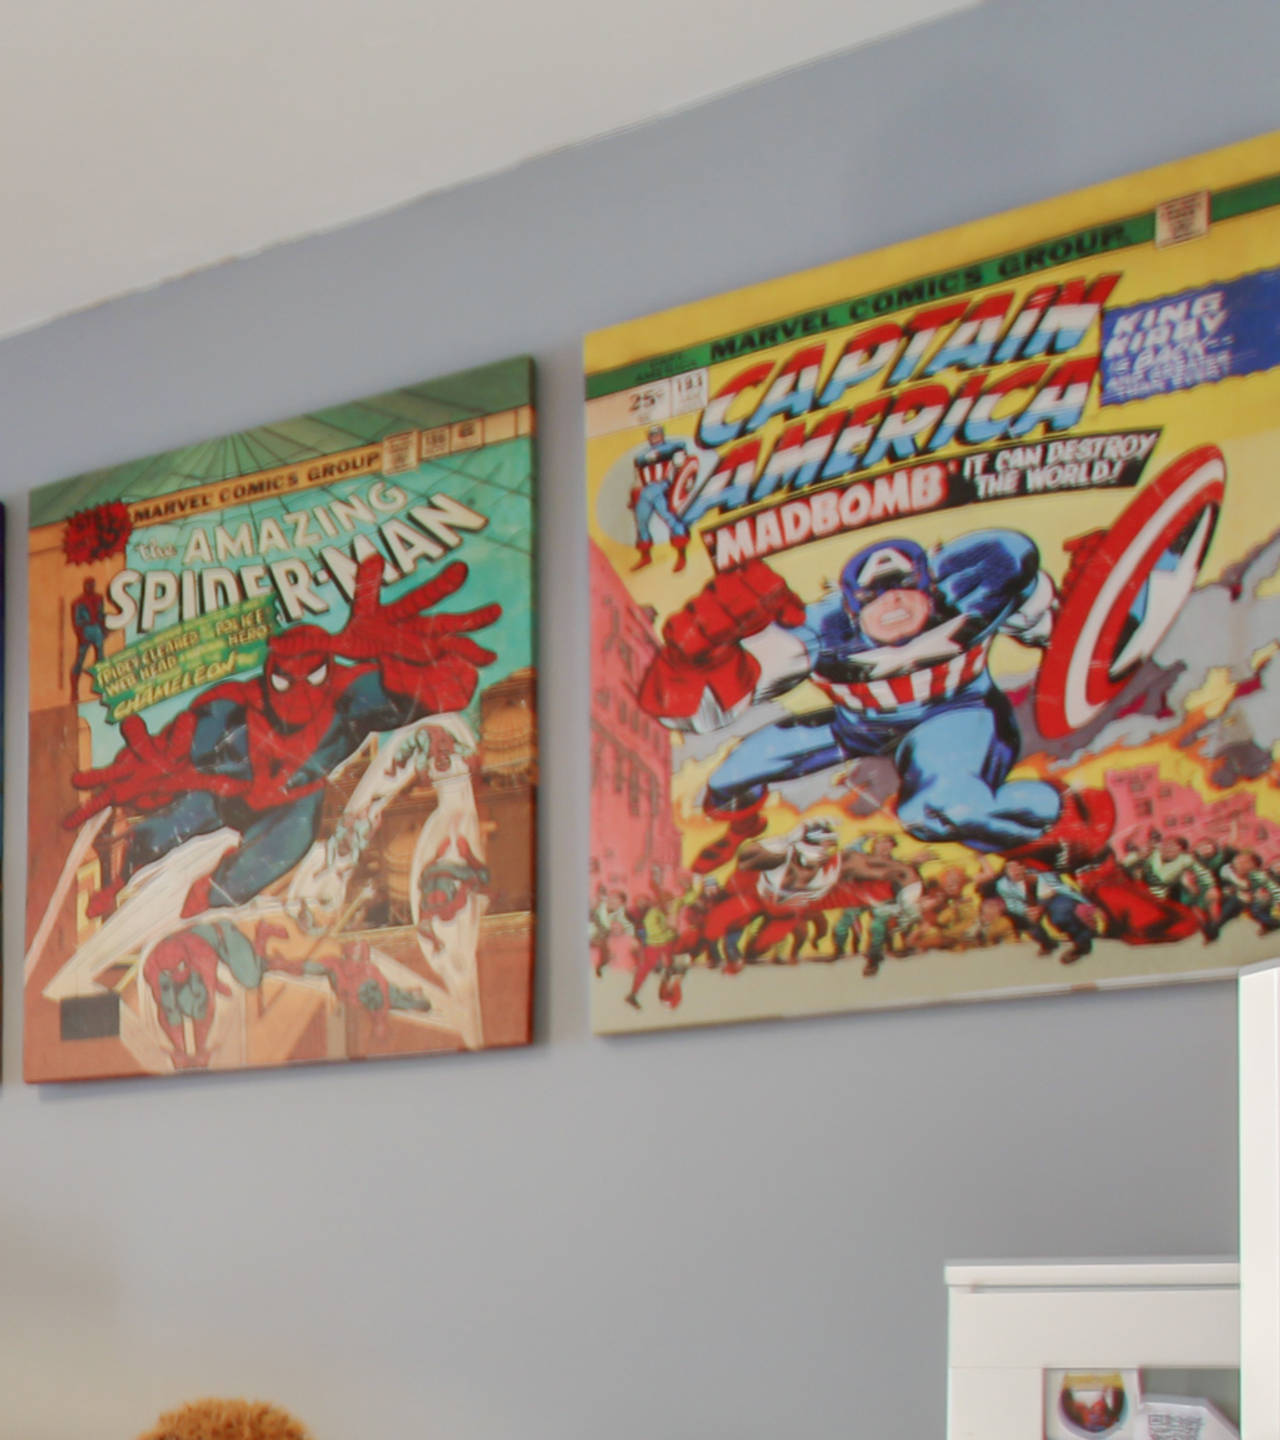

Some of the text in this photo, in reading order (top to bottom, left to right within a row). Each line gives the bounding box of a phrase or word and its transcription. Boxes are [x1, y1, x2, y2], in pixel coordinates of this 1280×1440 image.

[710, 225, 1126, 362] MARVEL COMICS GROUP
[1113, 292, 1225, 336] KING
[696, 272, 1124, 450] CAPTAIN
[676, 357, 1100, 526] AMERICA
[964, 431, 1158, 479] IT CAN DESTROY
[976, 459, 1124, 498] THE WORLD!
[134, 494, 211, 524] MARVEL
[219, 473, 299, 503] COMICS
[307, 451, 379, 483] GROUP
[182, 481, 408, 565] AMAZING
